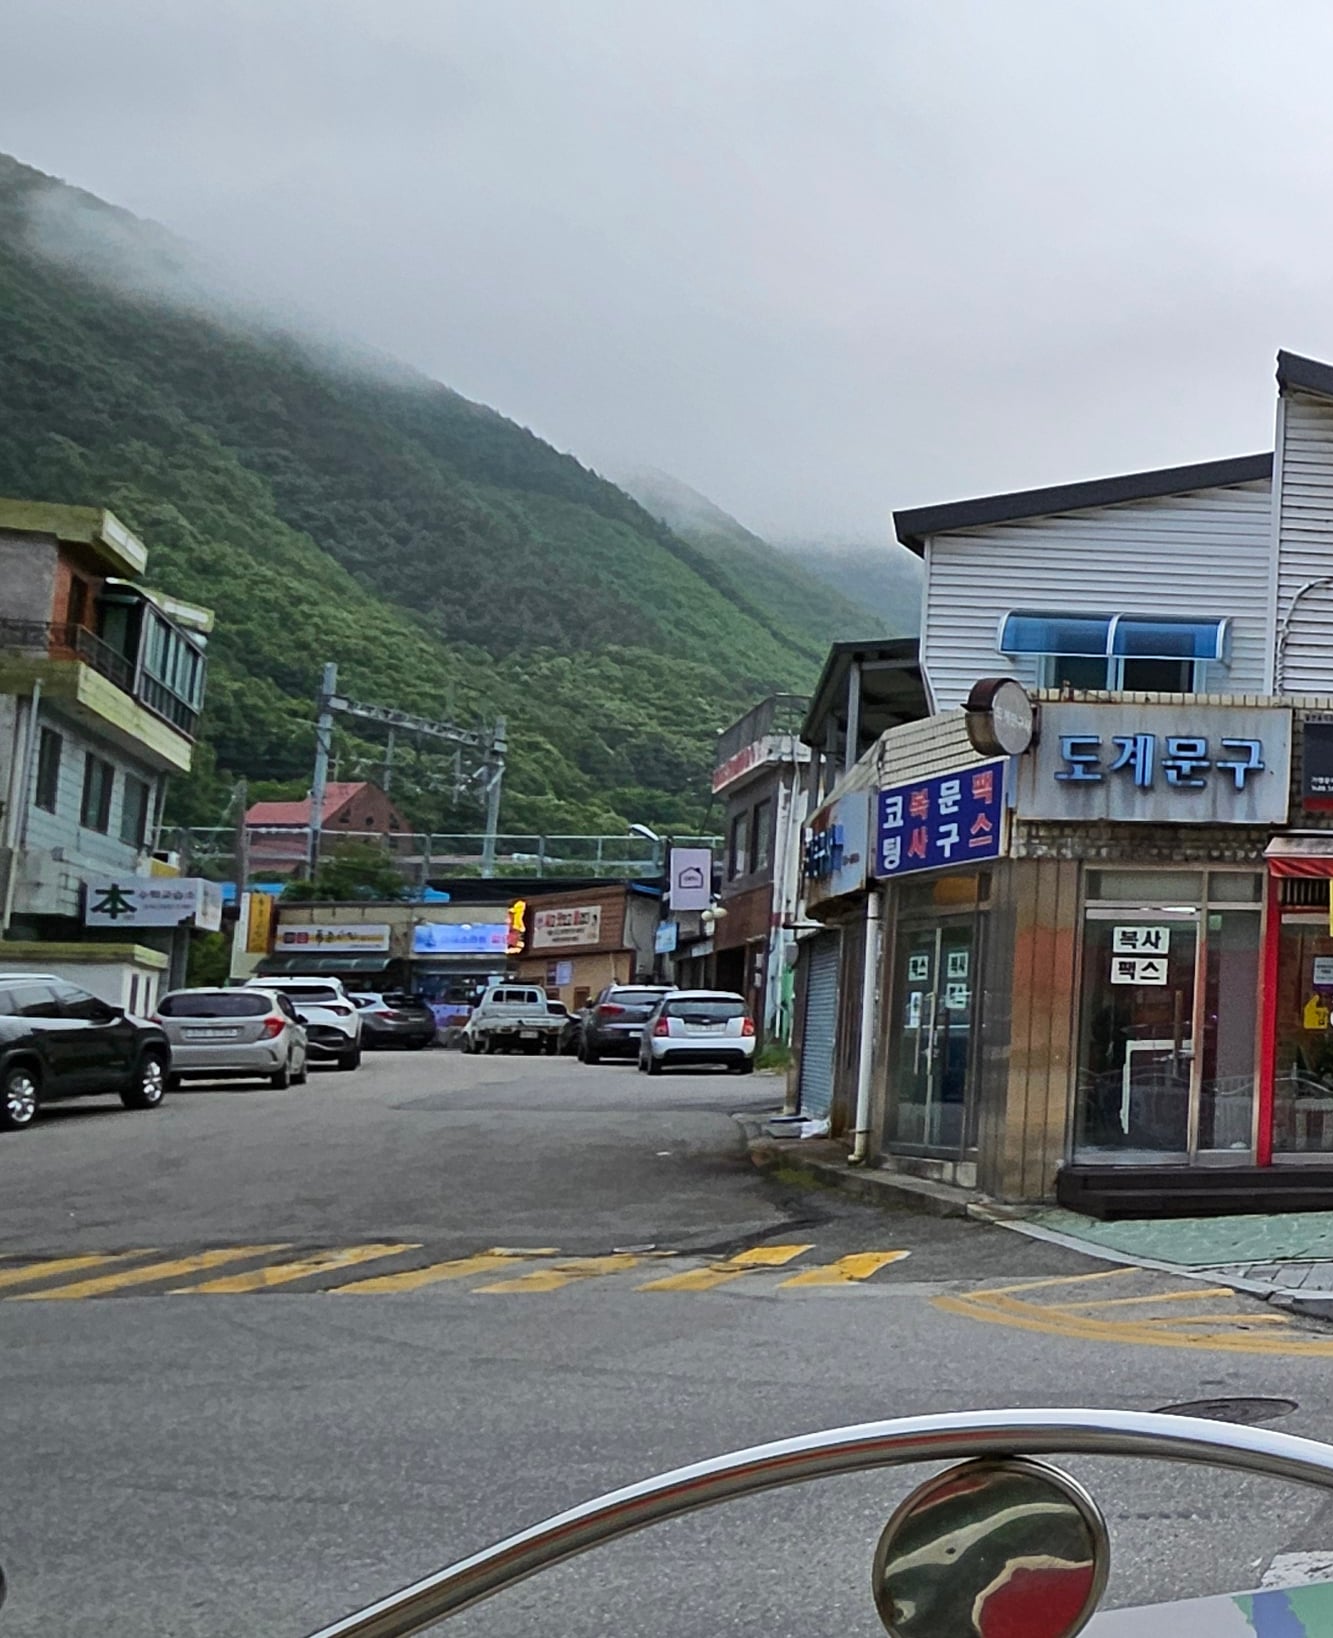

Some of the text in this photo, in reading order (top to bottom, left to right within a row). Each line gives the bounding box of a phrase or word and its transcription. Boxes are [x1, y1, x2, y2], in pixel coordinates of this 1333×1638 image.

[1054, 733, 1266, 791] 도계문구
[882, 796, 904, 870] 코팅
[907, 788, 929, 859] 복사
[936, 780, 962, 858] 문구
[968, 770, 993, 848] 팩스
[90, 883, 138, 919] 本
[1117, 961, 1160, 980] 팩스
[1119, 930, 1162, 949] 복사
